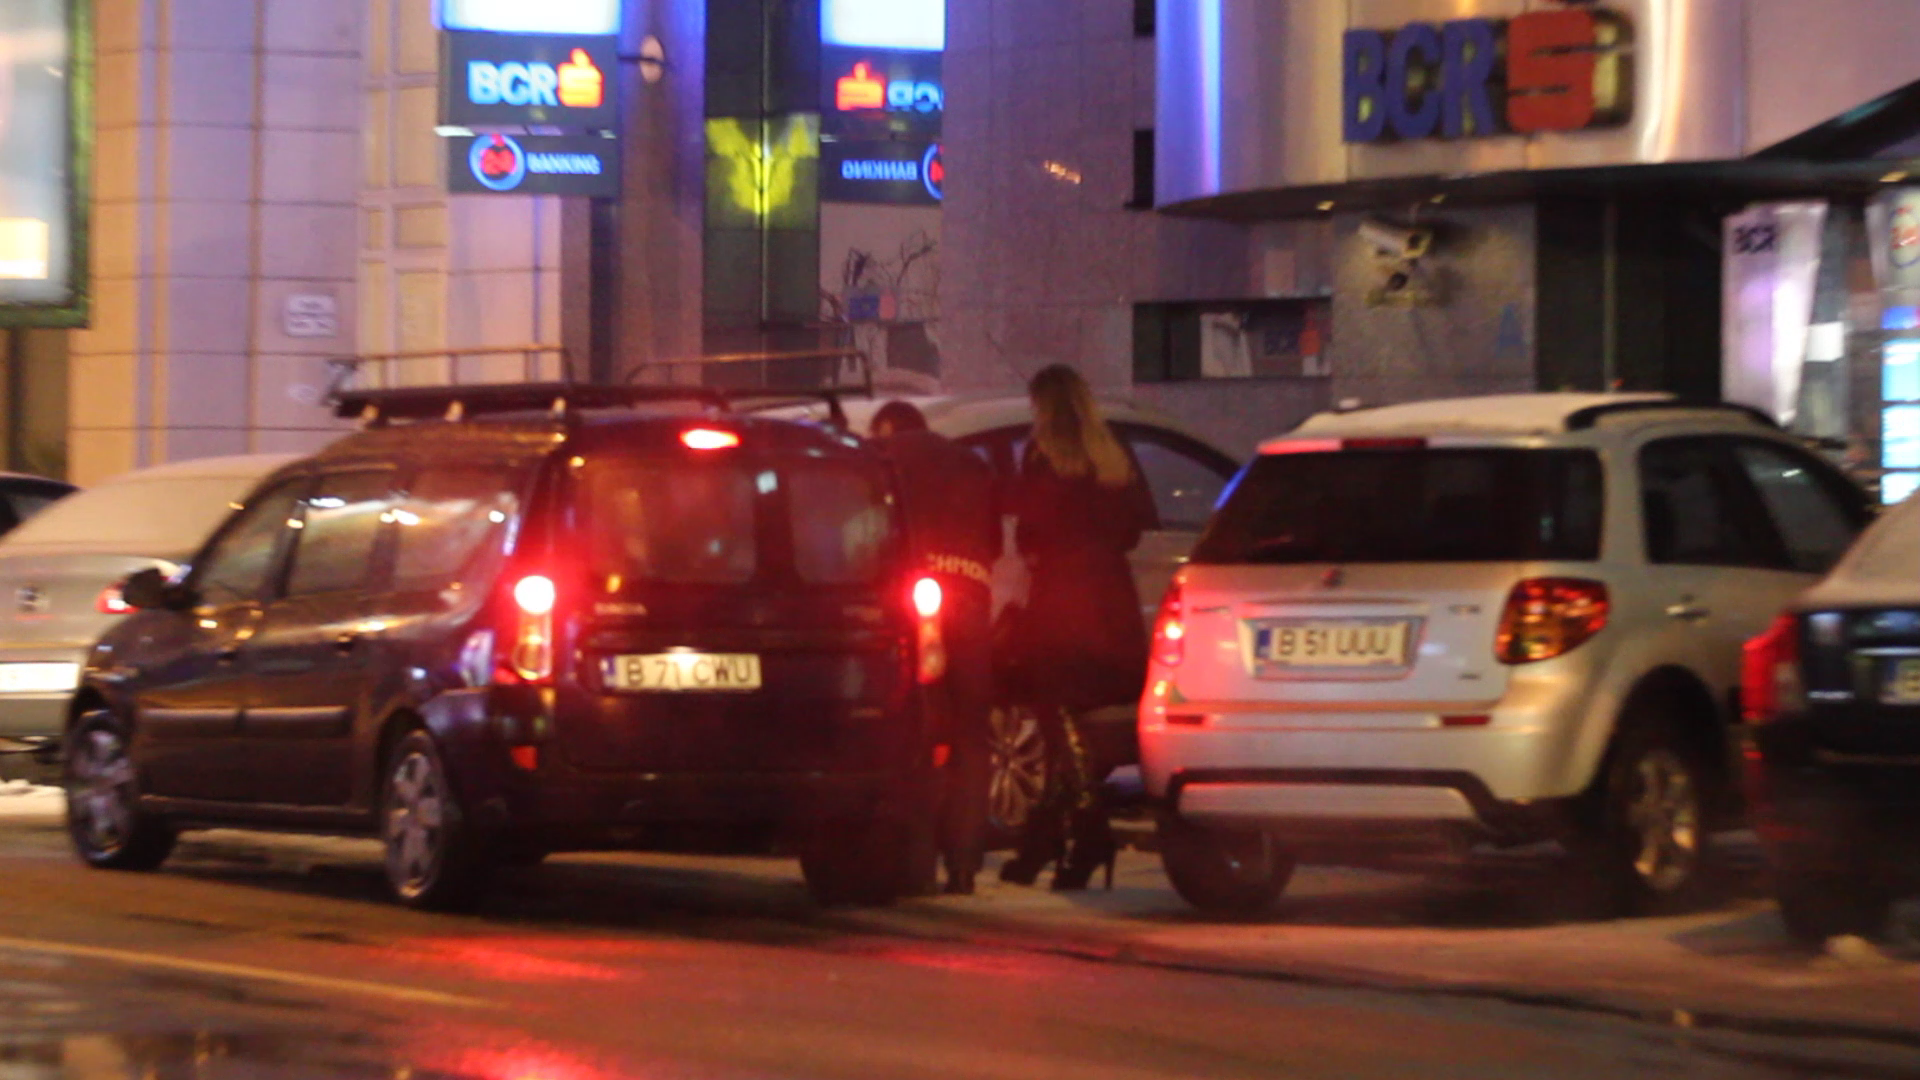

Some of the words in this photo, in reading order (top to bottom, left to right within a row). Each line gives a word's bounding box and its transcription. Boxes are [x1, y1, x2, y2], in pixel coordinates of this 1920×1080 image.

[467, 60, 558, 106] BCR
[1343, 18, 1496, 143] BCR
[526, 152, 602, 175] BANKING
[1278, 628, 1296, 656] B
[1304, 628, 1329, 656] 51
[1334, 628, 1391, 656] UUU
[626, 657, 644, 687] B
[654, 659, 682, 687] 71
[692, 658, 751, 685] CWU
